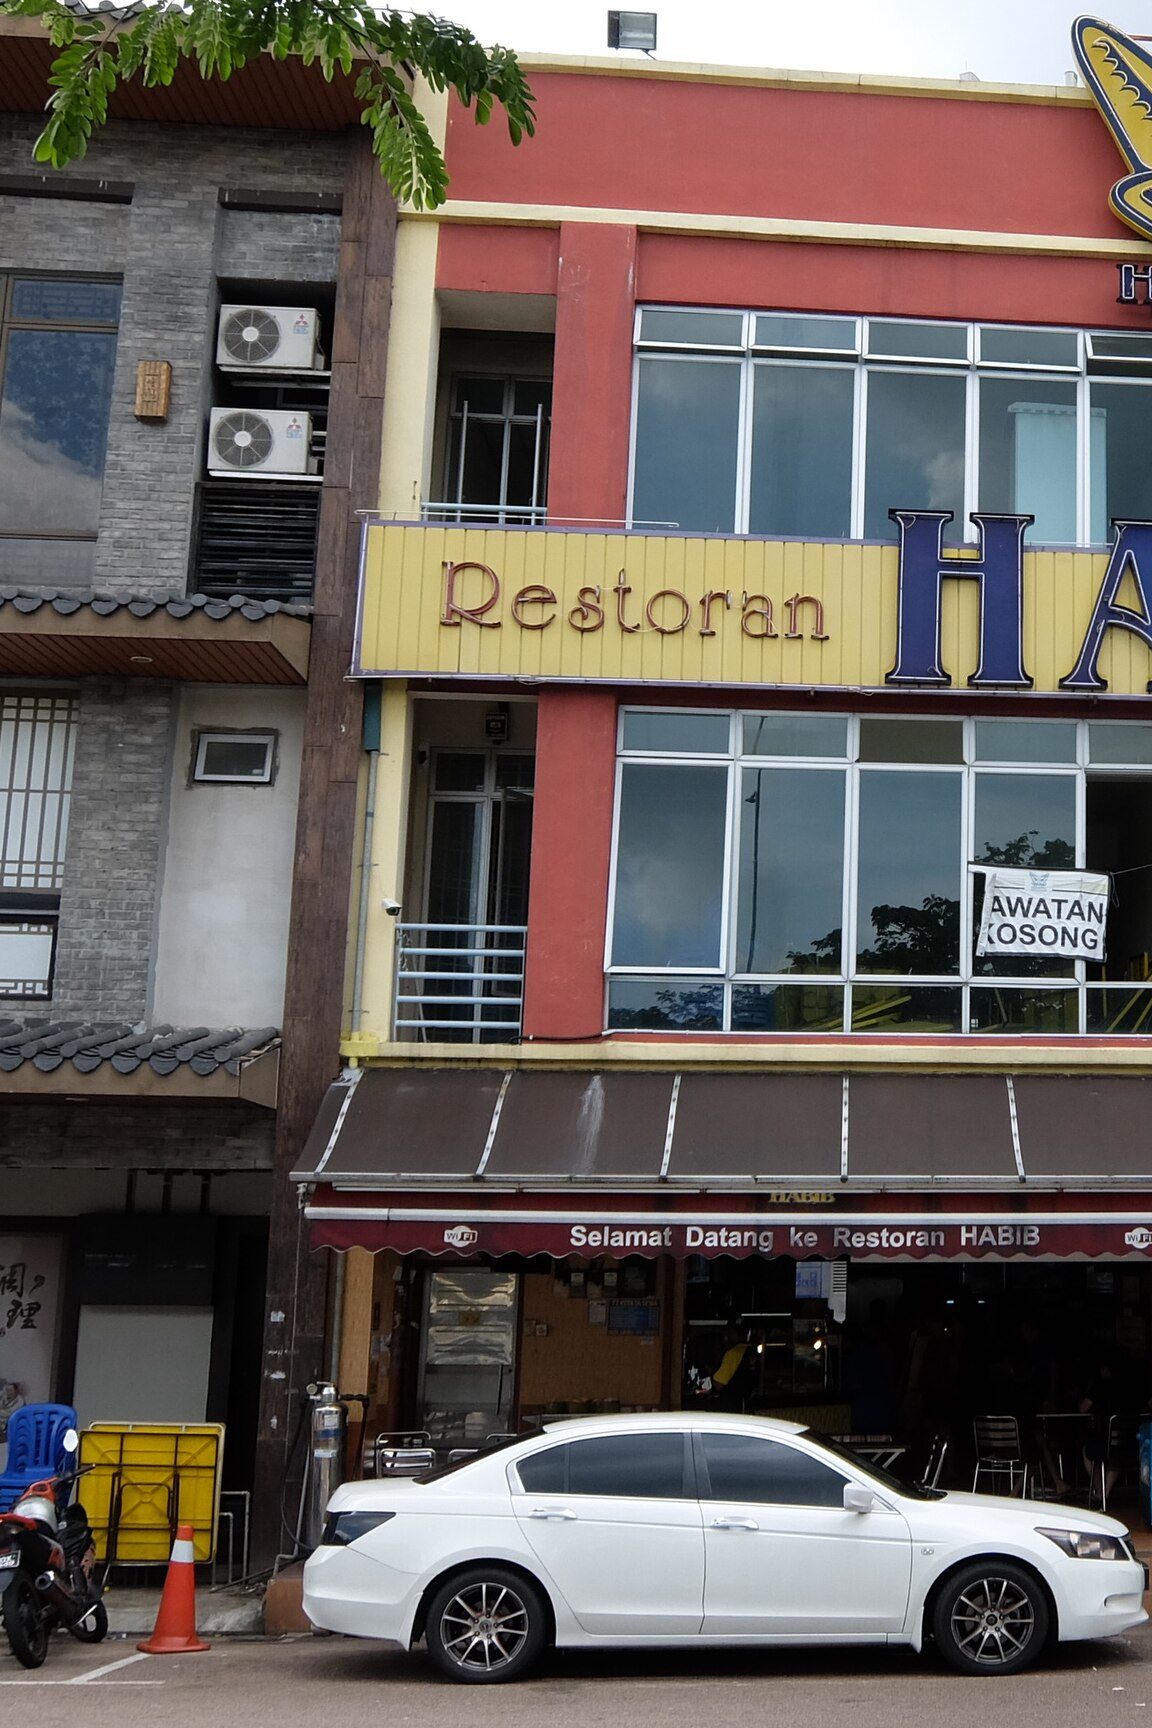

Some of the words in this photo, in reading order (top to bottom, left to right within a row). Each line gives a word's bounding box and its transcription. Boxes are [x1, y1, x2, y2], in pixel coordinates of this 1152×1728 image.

[440, 560, 830, 640] Restoran
[570, 1226, 671, 1247] Selamat
[686, 1226, 774, 1252] Datang
[790, 1227, 818, 1248] ke
[833, 1227, 945, 1248] Restoran
[960, 1226, 1040, 1247] HABIB
